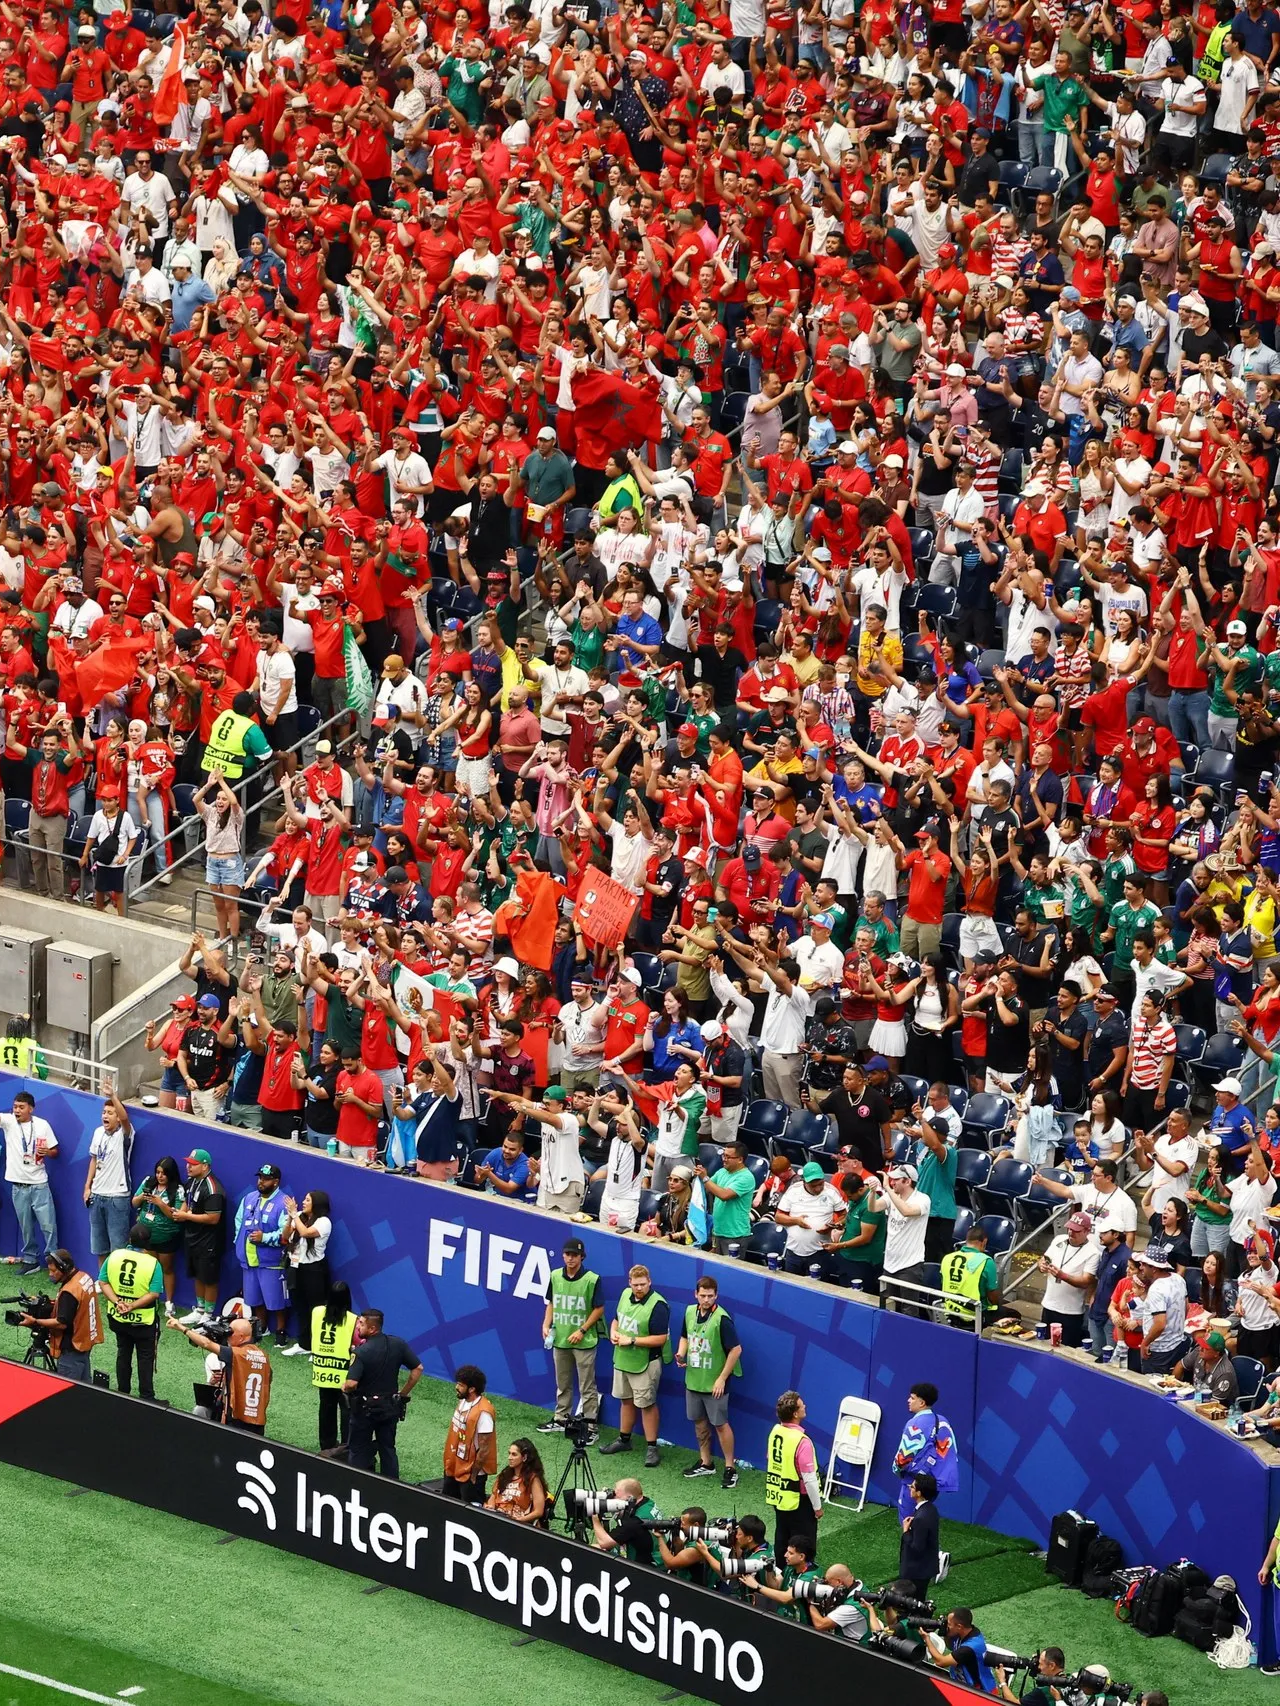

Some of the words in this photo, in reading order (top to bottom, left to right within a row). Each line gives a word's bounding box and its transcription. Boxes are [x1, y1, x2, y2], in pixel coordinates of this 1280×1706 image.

[1031, 423, 1044, 436] 20
[593, 872, 634, 908] HAKIMI
[616, 1019, 622, 1029] 7
[189, 1043, 214, 1057] bwin
[427, 1218, 552, 1305] FIFA
[552, 1294, 587, 1311] FIFA
[552, 1311, 587, 1327] PITCH
[297, 1473, 429, 1570] Inter
[445, 1521, 764, 1693] Rapidísimo
